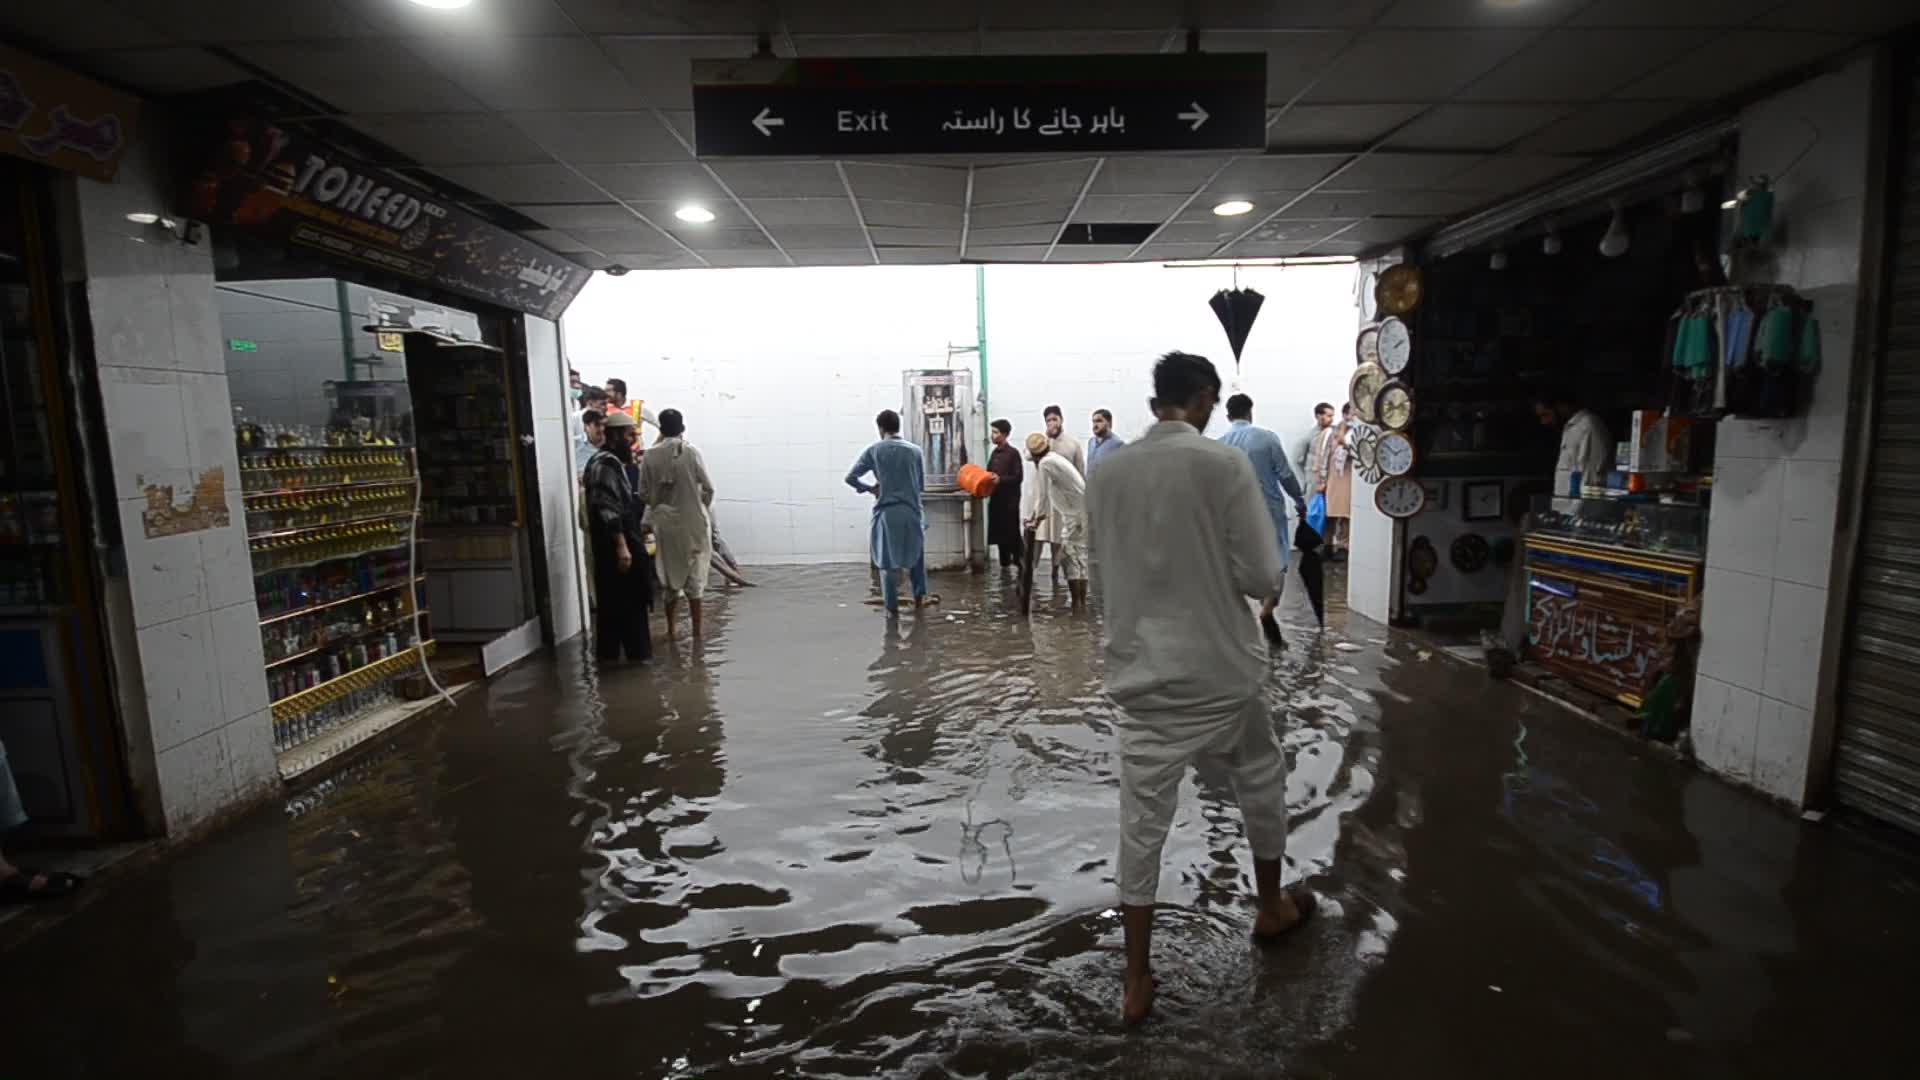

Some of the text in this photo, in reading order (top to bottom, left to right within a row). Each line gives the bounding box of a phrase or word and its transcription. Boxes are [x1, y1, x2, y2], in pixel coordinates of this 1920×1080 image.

[837, 110, 889, 132] Exit
[942, 106, 1126, 135] باہر جانے کا راستہ
[295, 154, 421, 230] TOHEED
